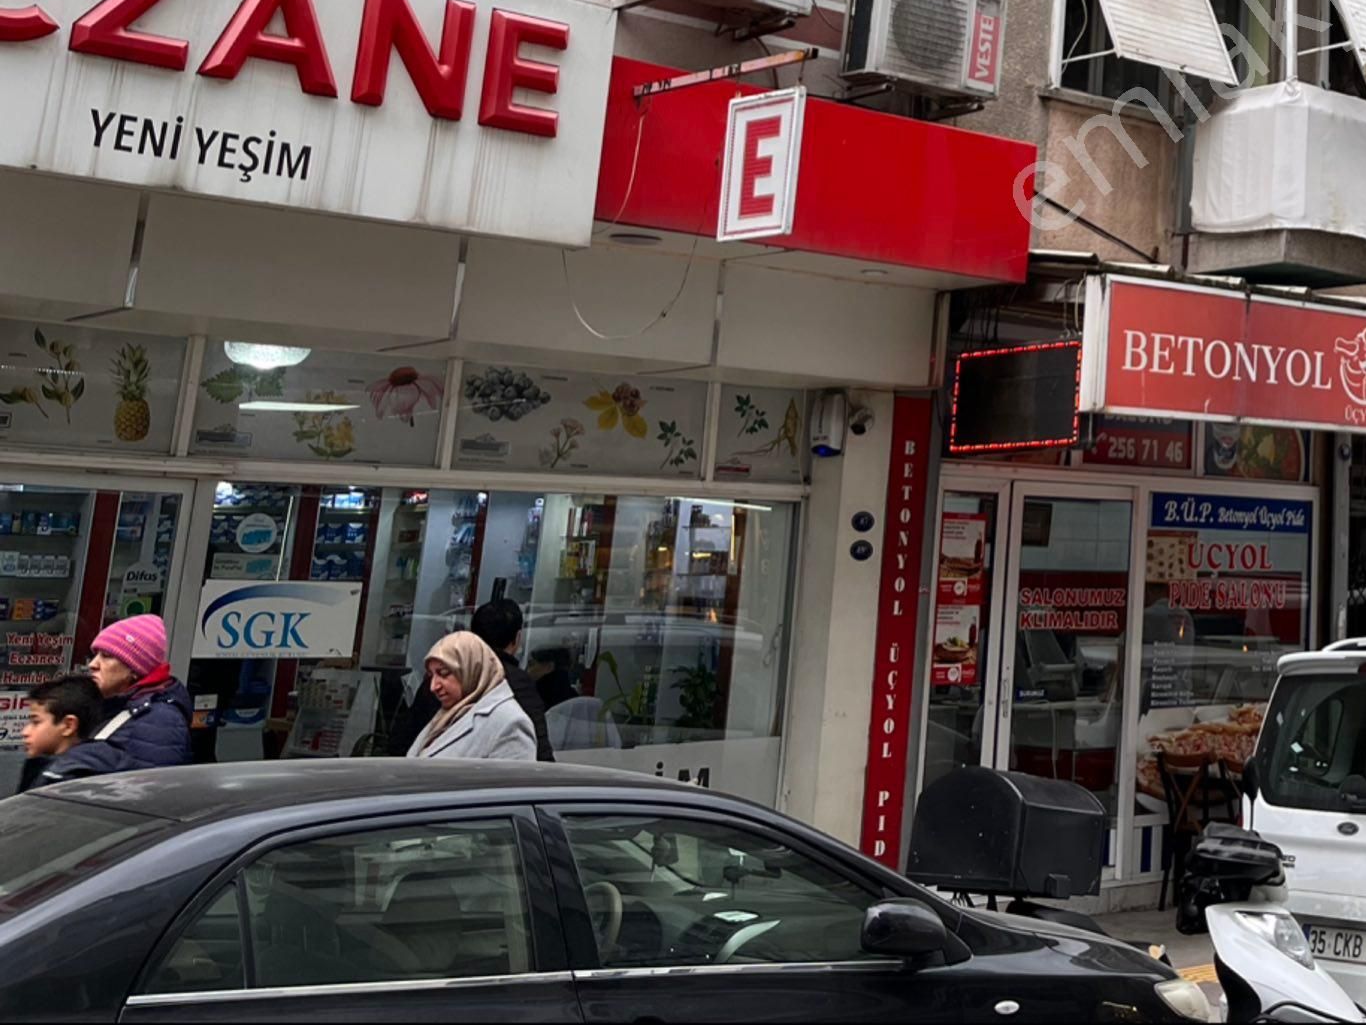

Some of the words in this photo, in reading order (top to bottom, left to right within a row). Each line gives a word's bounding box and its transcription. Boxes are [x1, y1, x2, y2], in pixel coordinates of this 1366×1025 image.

[90, 108, 184, 161] YENİ
[195, 127, 312, 183] YEŞİM
[738, 115, 783, 220] E
[1121, 328, 1333, 391] BETONYOL
[1107, 436, 1136, 460] 256
[1142, 438, 1159, 462] 71
[1165, 440, 1184, 463] 46
[891, 439, 917, 617] BETONYOL
[1217, 505, 1260, 529] Betonyol
[1019, 587, 1127, 608] SALONUMUZ
[1215, 580, 1287, 610] SALONU
[7, 632, 33, 647] Yeni
[217, 611, 312, 650] SGK
[9, 652, 65, 666] Eczanesi
[880, 641, 902, 760] ÜÇYOL
[1311, 930, 1326, 954] 35
[1333, 932, 1363, 958] CKB
